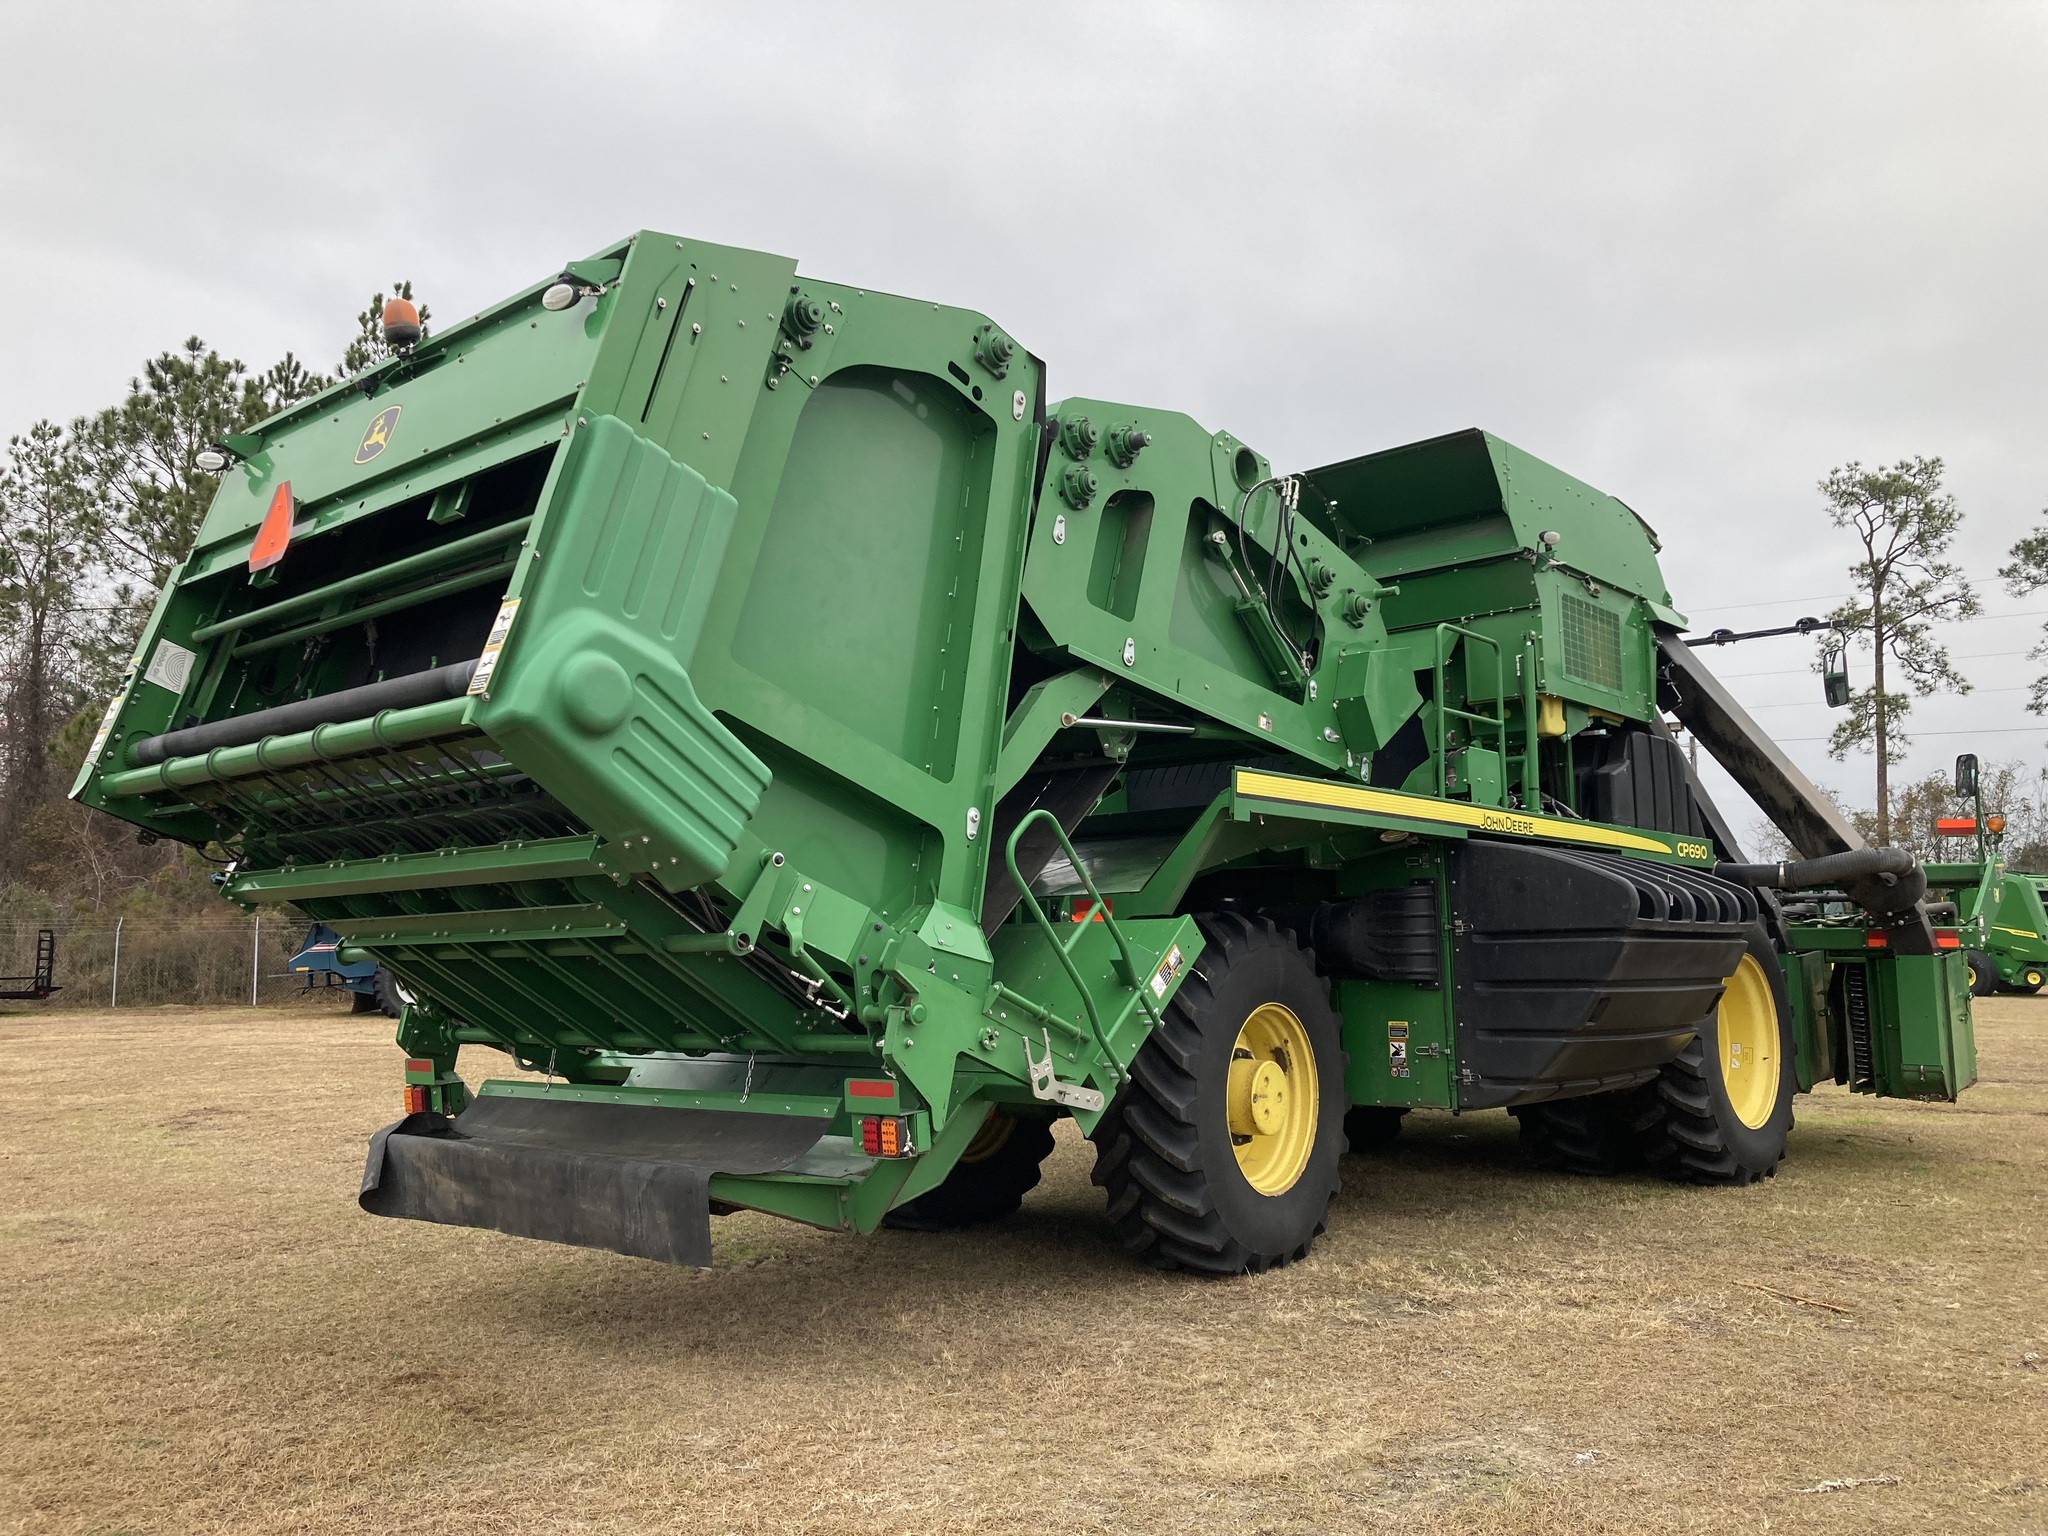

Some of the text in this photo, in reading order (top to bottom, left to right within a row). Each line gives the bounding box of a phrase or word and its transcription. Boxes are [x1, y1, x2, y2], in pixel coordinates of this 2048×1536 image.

[1480, 813, 1534, 834] JOHN DEERE
[1677, 842, 1708, 860] CP690
